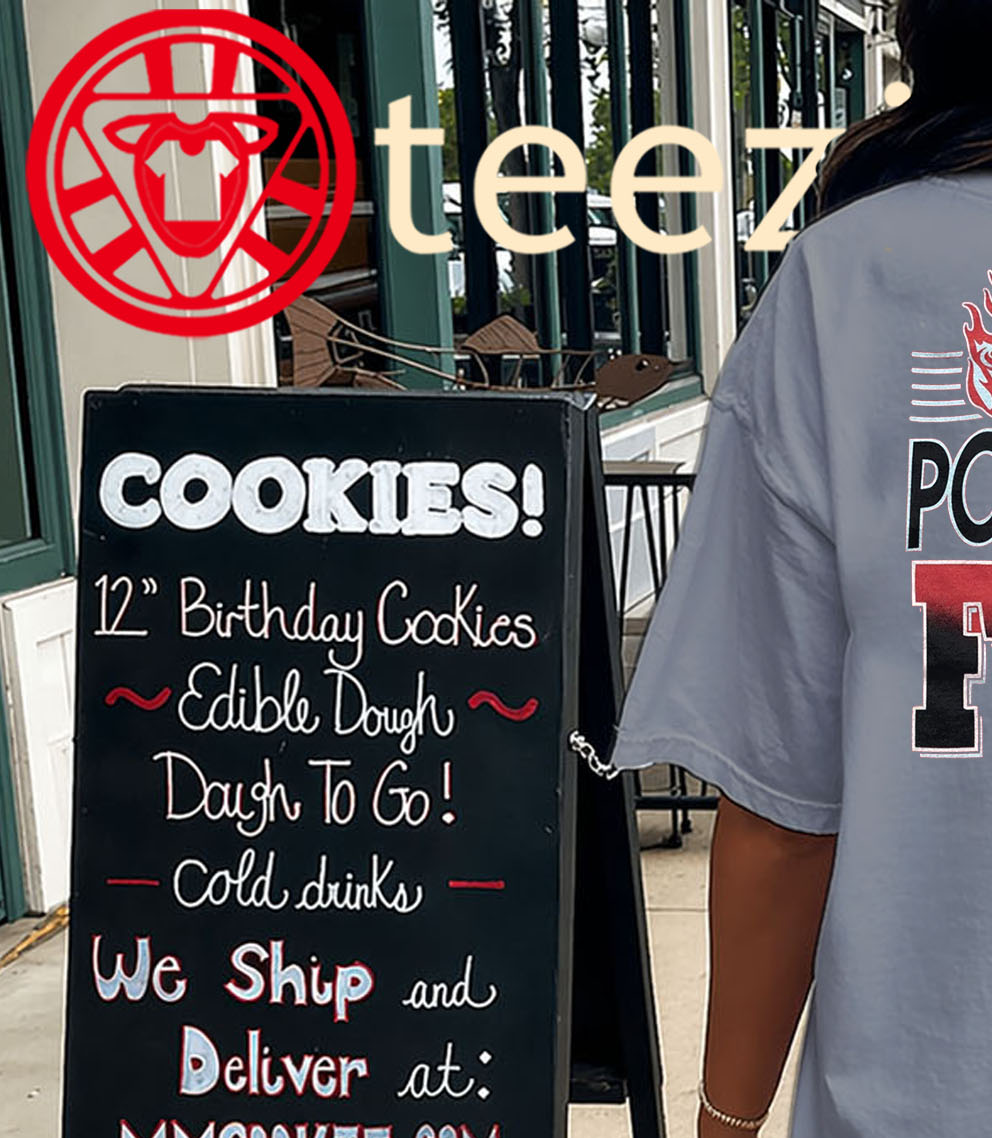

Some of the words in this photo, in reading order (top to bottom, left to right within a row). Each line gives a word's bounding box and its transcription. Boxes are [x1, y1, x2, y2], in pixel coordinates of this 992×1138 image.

[99, 452, 546, 539] COOKIES!
[179, 576, 363, 671] Birthday
[177, 662, 320, 734] Edible
[323, 667, 455, 755] Dough
[308, 759, 356, 824] To
[173, 847, 290, 910] Cold
[92, 935, 188, 1003] We
[224, 939, 375, 1023] Ship
[402, 954, 497, 1009] and
[179, 1025, 370, 1098] Deliver
[397, 1041, 493, 1100] at:
